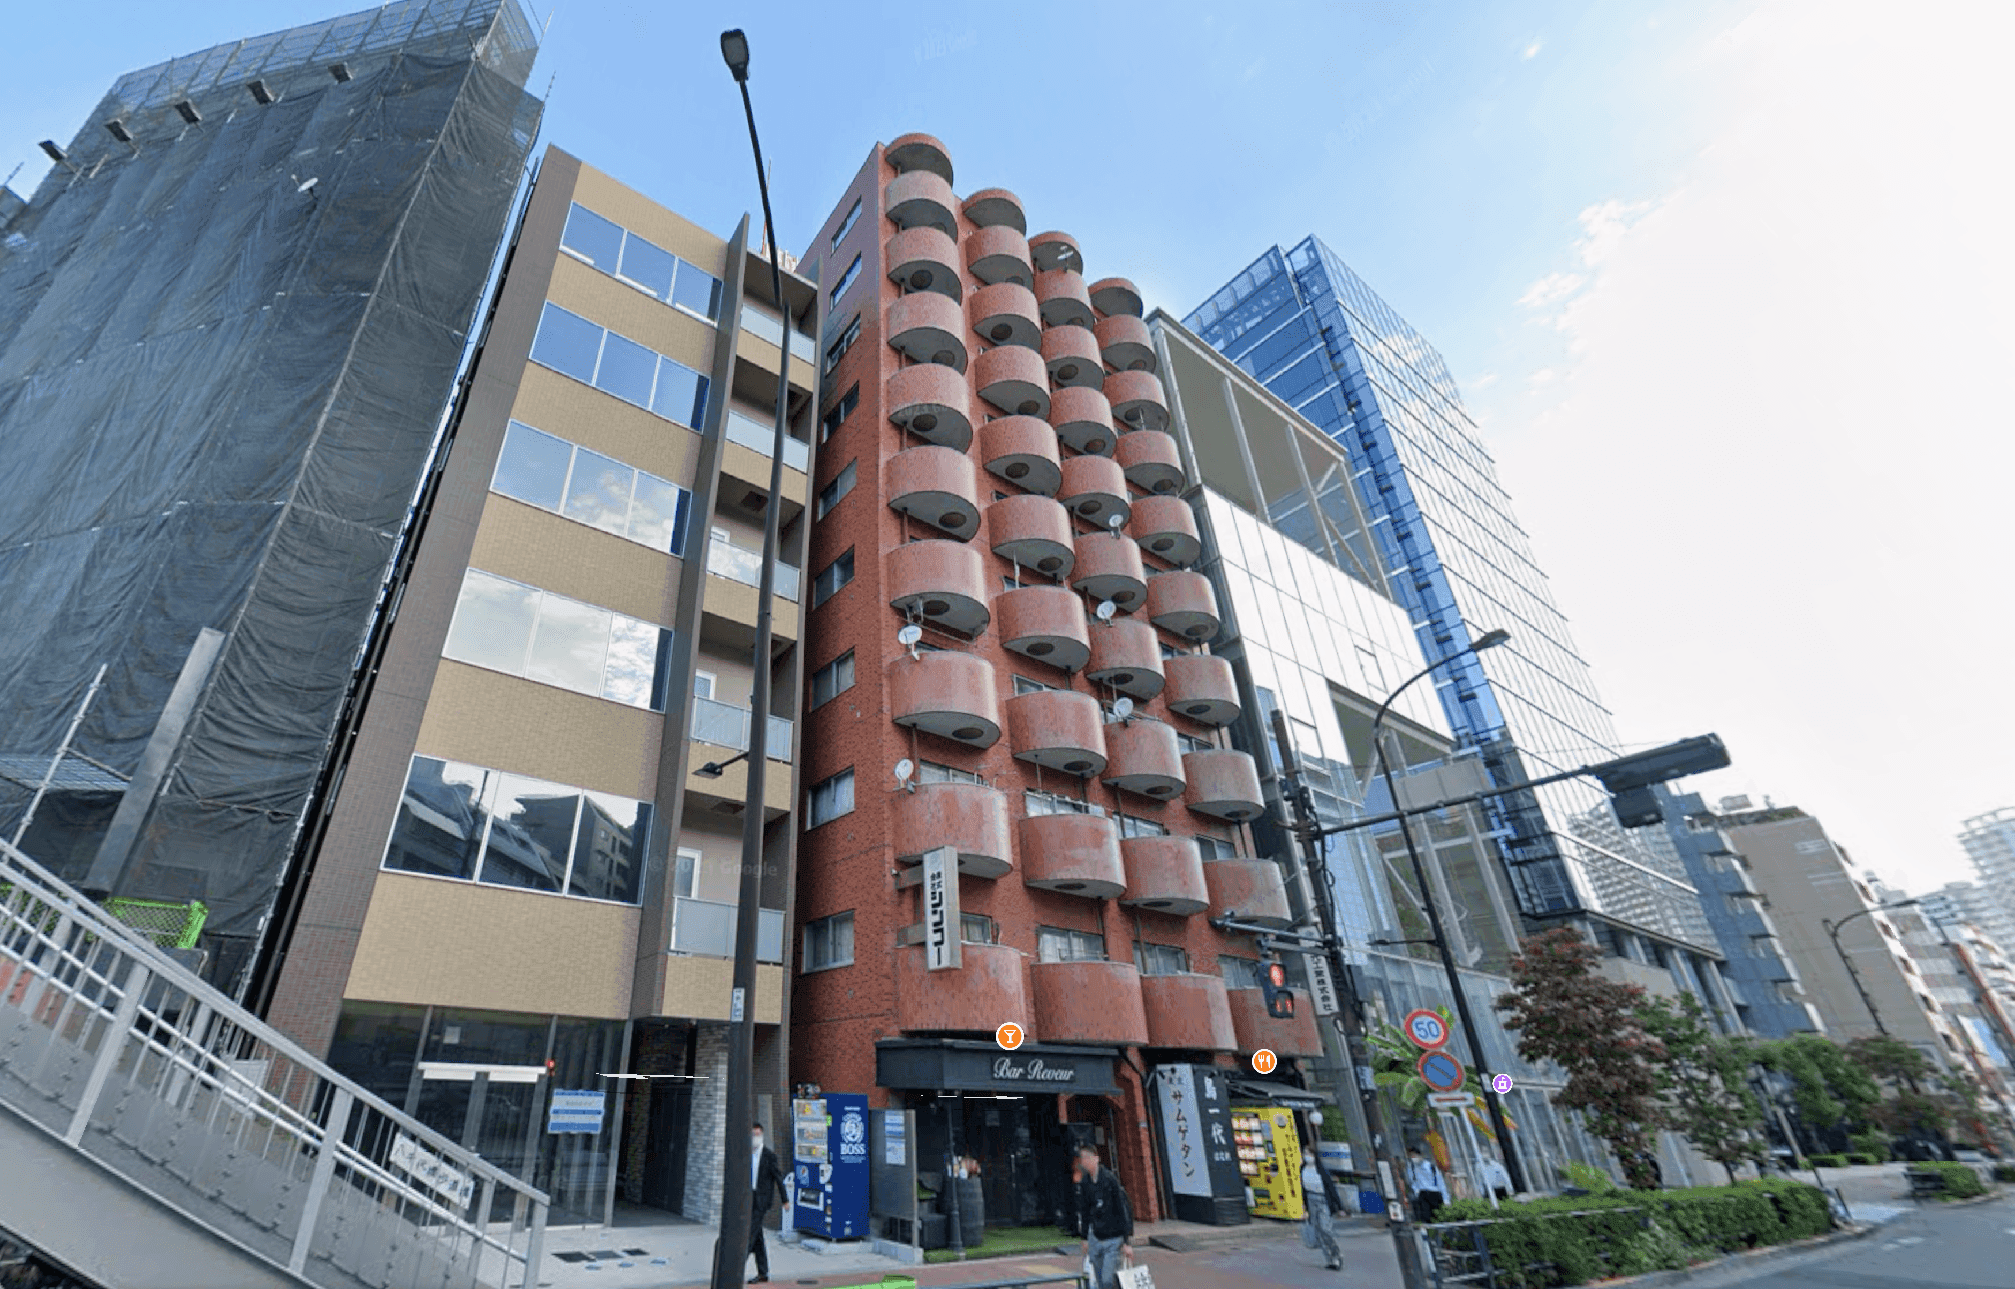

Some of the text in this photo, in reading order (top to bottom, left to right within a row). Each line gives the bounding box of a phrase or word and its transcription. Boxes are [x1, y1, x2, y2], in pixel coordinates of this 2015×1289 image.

[1413, 1020, 1440, 1040] 50
[992, 1056, 1025, 1080] Bar
[840, 1143, 867, 1156] BOSS
